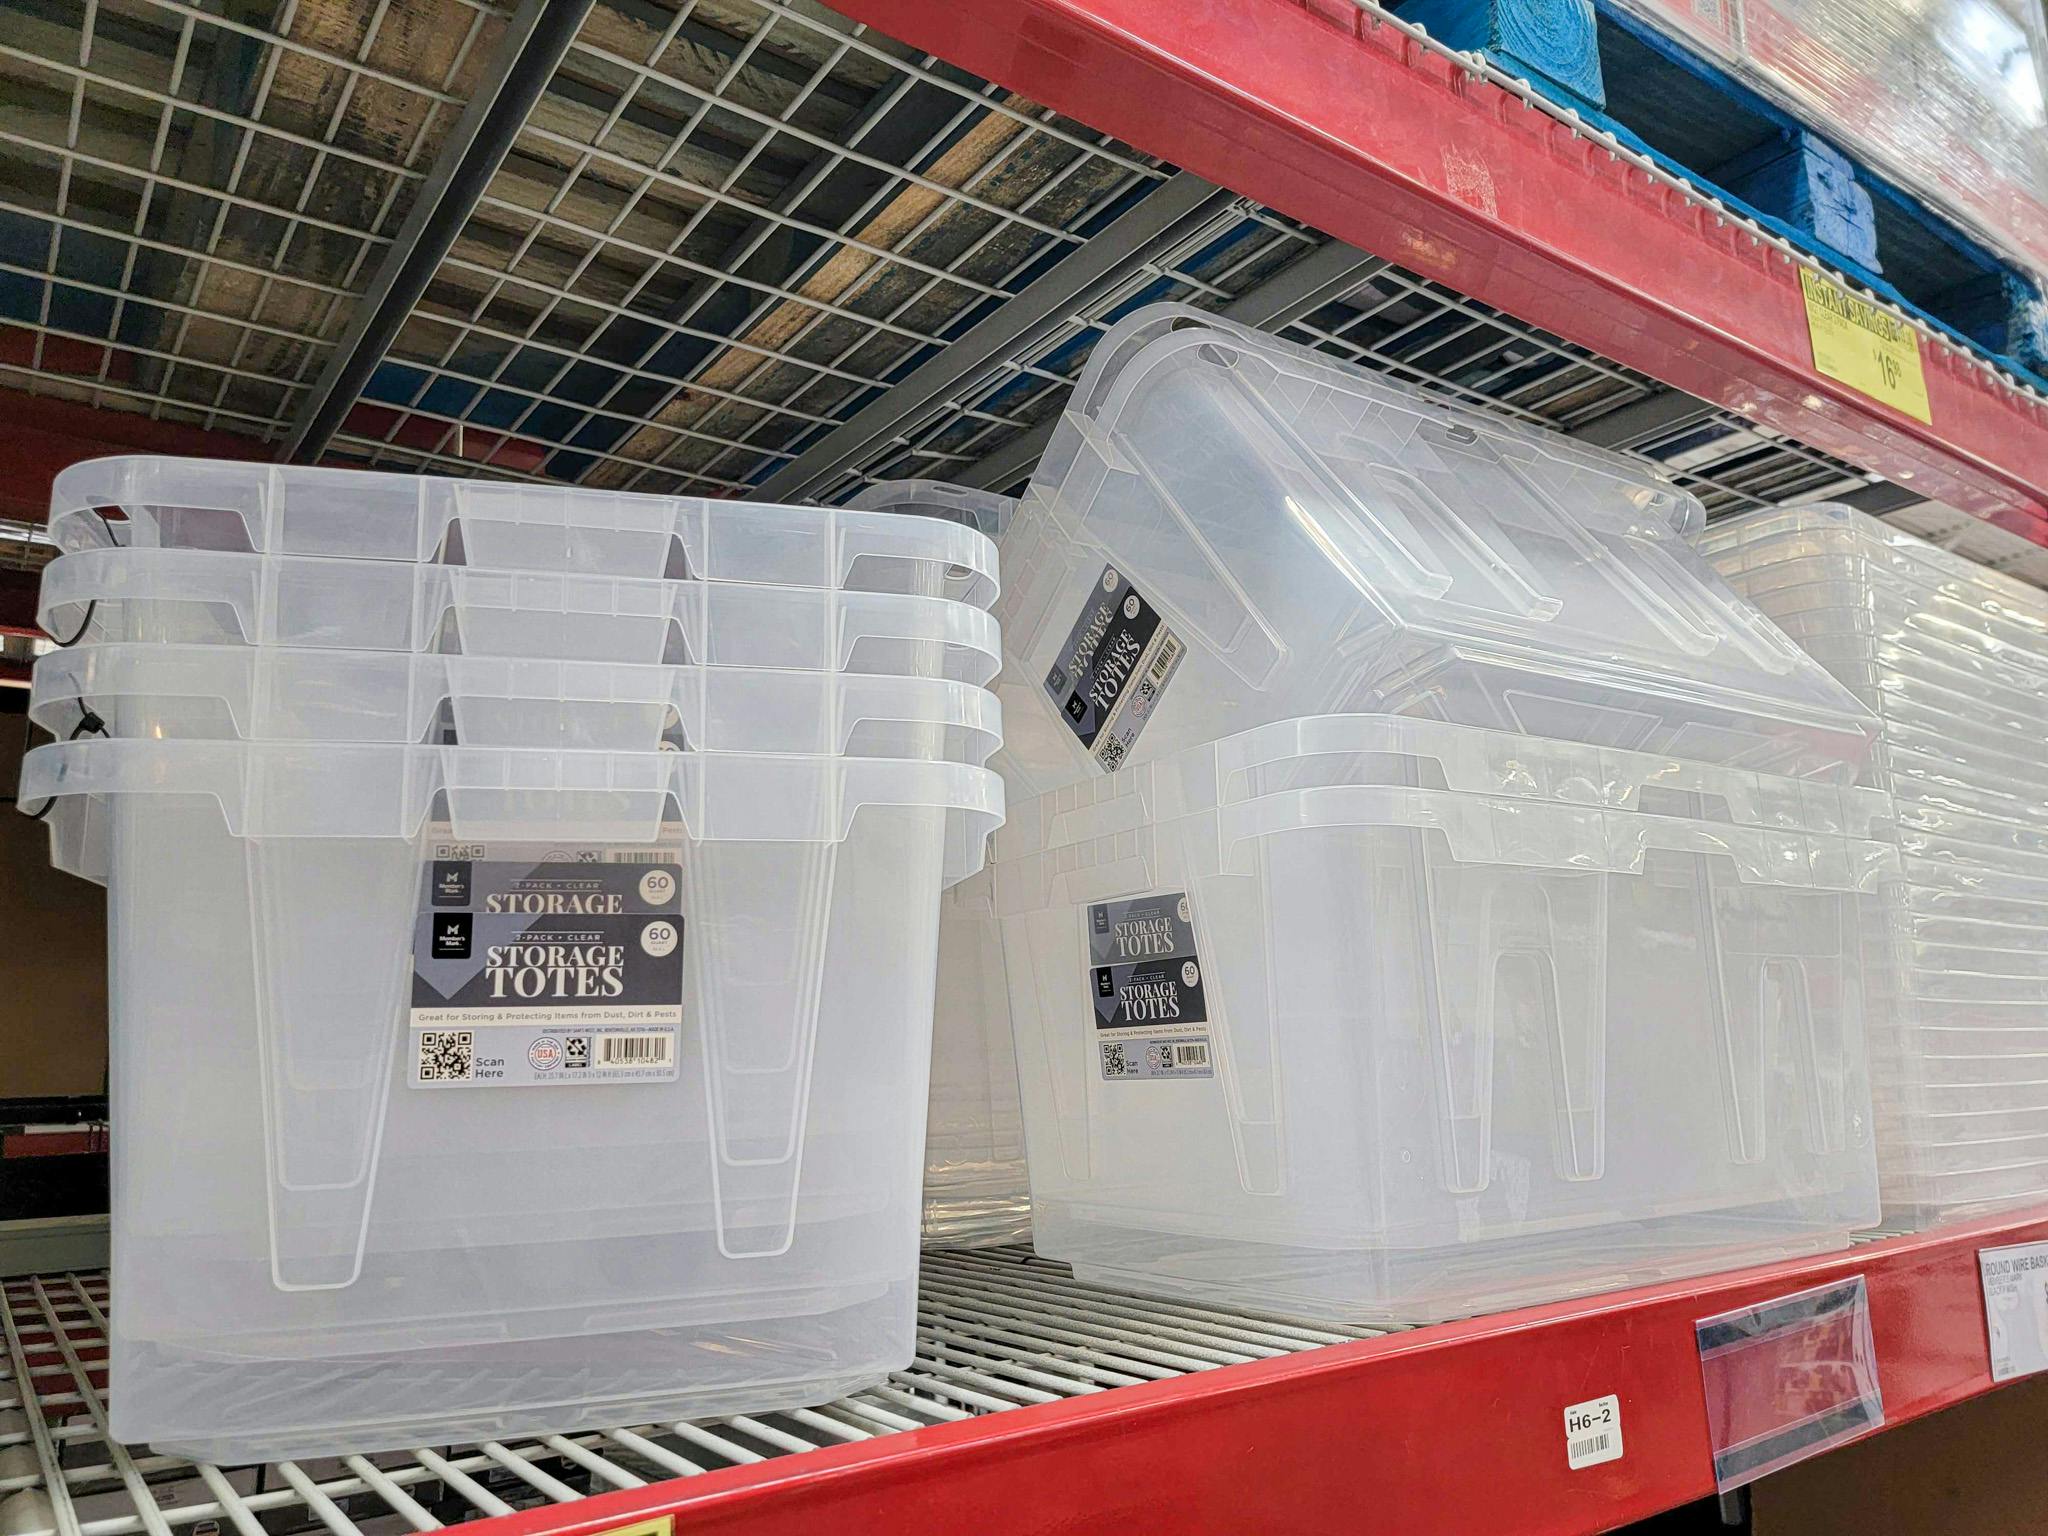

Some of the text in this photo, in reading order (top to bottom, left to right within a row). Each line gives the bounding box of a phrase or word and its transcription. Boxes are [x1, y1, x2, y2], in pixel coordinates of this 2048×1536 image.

[1125, 599, 1135, 612] 60
[1069, 602, 1111, 674] STORAGE
[1089, 629, 1132, 702] STORAGE
[1094, 641, 1140, 711] TOTES
[1122, 728, 1131, 741] Scan
[1126, 732, 1135, 747] Here
[648, 877, 668, 888] 60
[486, 894, 622, 914] STORAGE
[649, 928, 670, 940] 60
[1115, 917, 1172, 936] STORAGE
[1116, 932, 1174, 956] TOTES
[486, 945, 624, 967] STORAGE
[1185, 966, 1195, 975] 60
[485, 966, 623, 998] TOTES
[1120, 981, 1177, 1000] STORAGE
[462, 1013, 494, 1022] Storing
[506, 1012, 552, 1021] Protecting
[655, 1010, 677, 1018] Pests
[1121, 996, 1180, 1020] TOTES
[476, 1058, 504, 1067] Scan
[537, 1049, 553, 1058] USA
[475, 1069, 504, 1078] Here
[1986, 1260, 2010, 1276] ROUND
[2012, 1257, 2029, 1272] WIRE
[1569, 1408, 1611, 1432] H6-2
